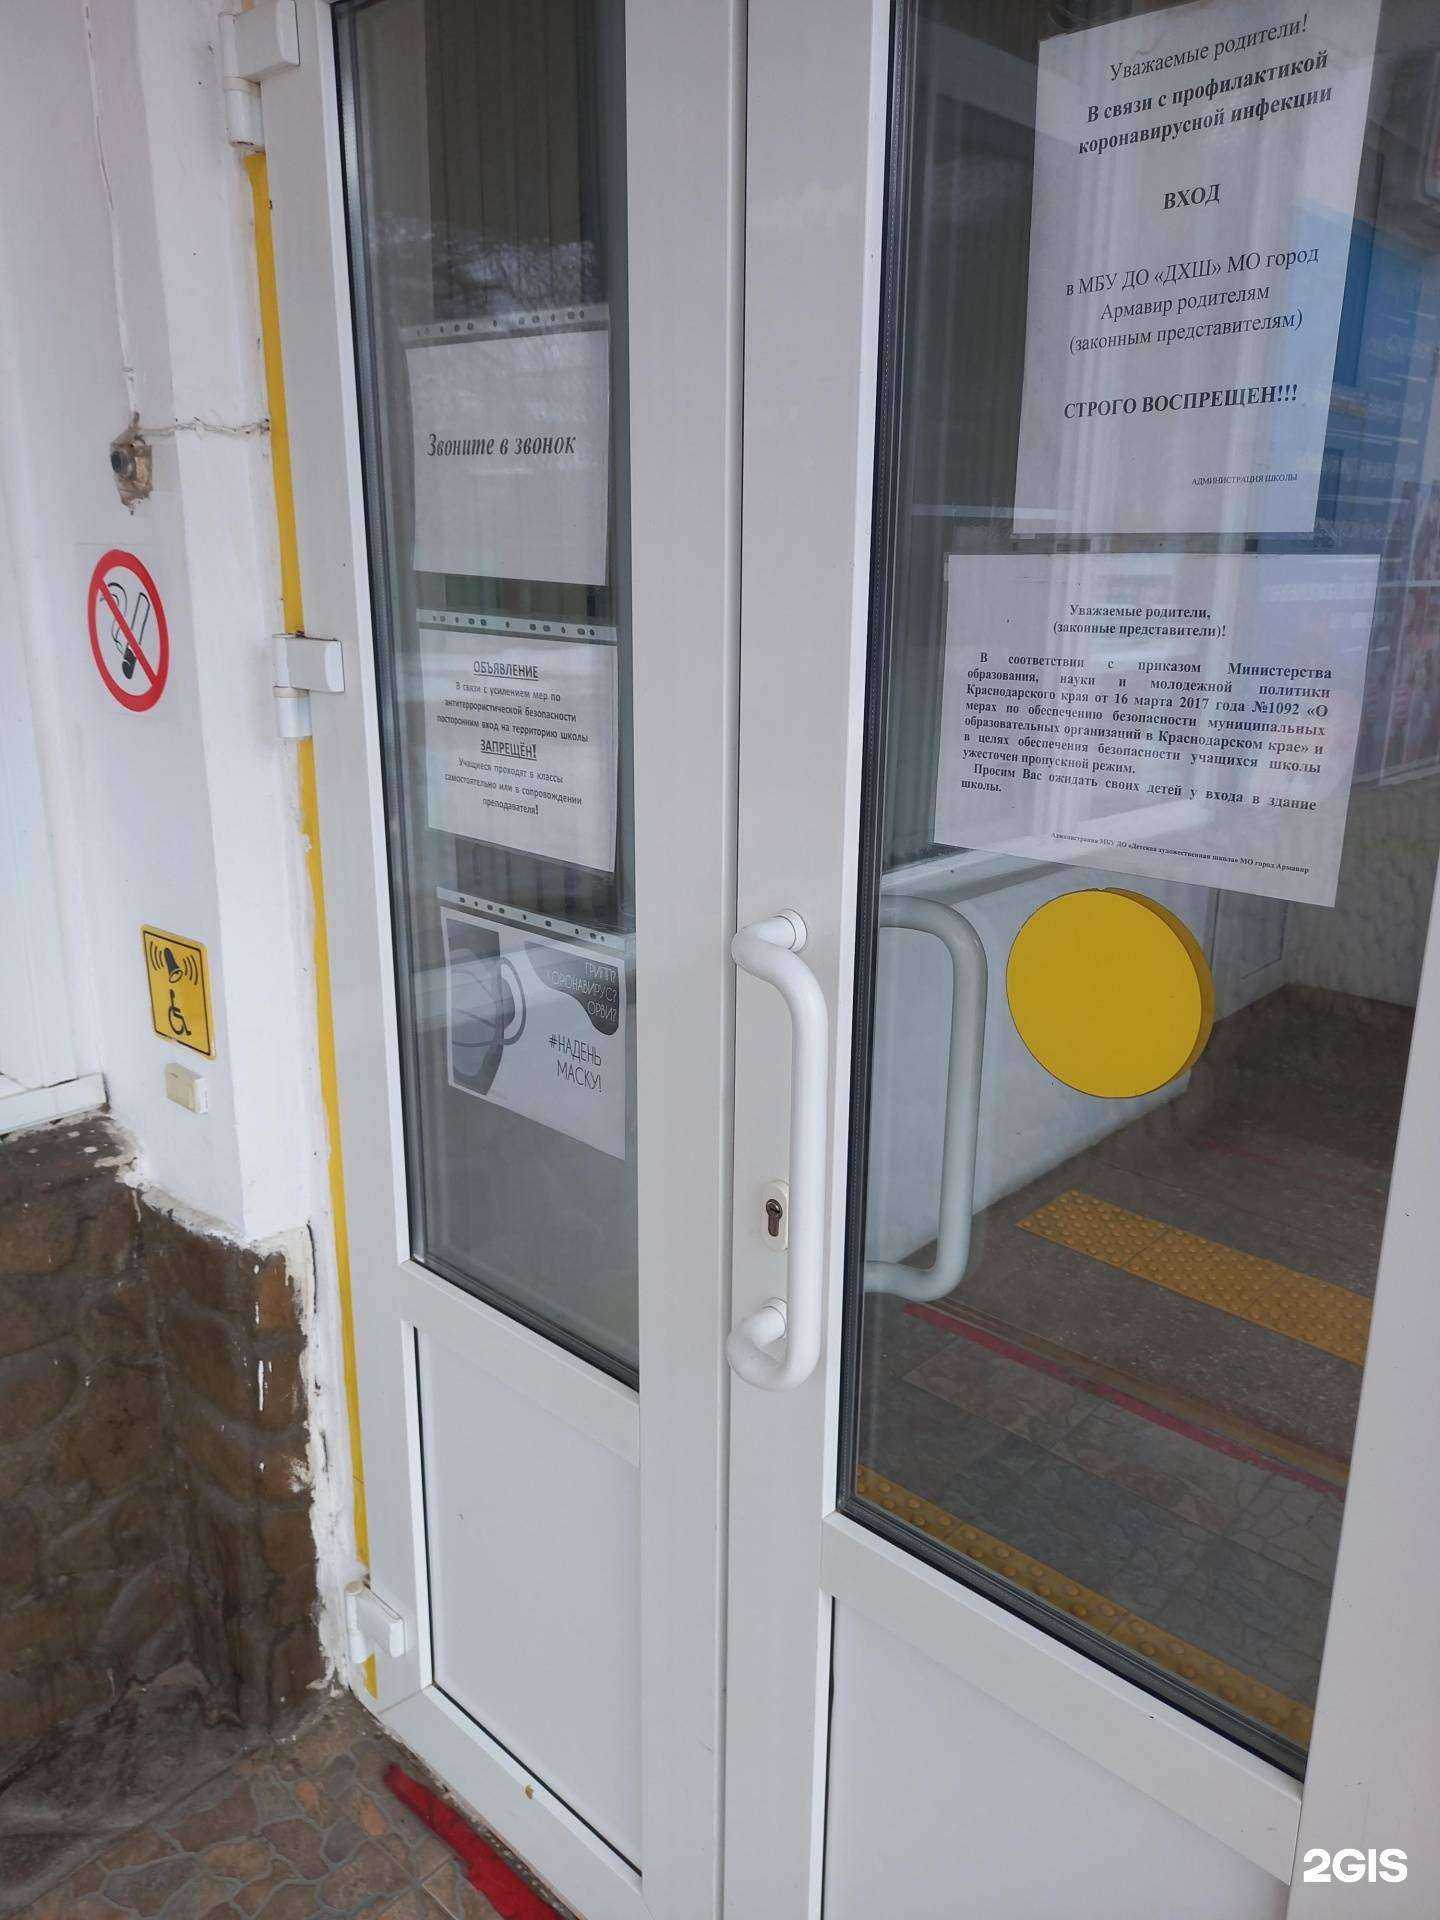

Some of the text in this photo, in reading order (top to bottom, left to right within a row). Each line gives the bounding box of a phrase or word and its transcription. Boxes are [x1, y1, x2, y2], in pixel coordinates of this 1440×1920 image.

[1109, 13, 1308, 82] Уважаемые родители!
[1087, 50, 1328, 123] В связи с профилактикой
[1078, 85, 1333, 155] коронавирусной инфекции
[1163, 184, 1220, 210] ВХОД
[1066, 247, 1319, 296] в МБУ ДО «ДХШ» МО город
[1101, 286, 1270, 321] Армавир родителям
[1069, 309, 1303, 354] (законным представителям)
[1065, 384, 1297, 419] СТРОГО ВОСПРЕЩЕН!!!
[427, 433, 576, 457] Звоните в звонок
[1192, 473, 1298, 486] АДМИНИСТРАЦИЯ ШКОЛЫ
[1070, 604, 1211, 621] Уважаемые родители,
[1053, 622, 1226, 639] (законные представители)!
[473, 660, 539, 680] ОБЪЯВЛЕНИЕ
[980, 653, 988, 663] В
[1008, 655, 1084, 668] соответствии
[1138, 661, 1201, 673] приказом
[1227, 663, 1332, 680] Министерства
[462, 684, 481, 693] связи
[490, 687, 530, 699] усилением
[532, 692, 547, 702] мер
[550, 694, 561, 702] по
[967, 669, 1330, 698] образования, науки и молодежной политики
[525, 707, 577, 723] безопасности
[966, 684, 1328, 717] Краснодарского края от 16 марта 2017 года №1092 «О
[482, 722, 499, 731] вход
[502, 724, 510, 732] на
[512, 726, 557, 741] территорию
[560, 733, 589, 743] школы
[965, 702, 1326, 736] мерах по обеспечению безопасности муниципальных
[481, 738, 537, 760] ЗАПРЕЩЁН!
[965, 716, 1323, 755] образовательных организаций в Краснодарском крае» и
[962, 747, 1136, 774] ужесточен пропускной режим.
[964, 733, 1321, 773] в целях обеспечения безопасности учащихся школы
[458, 757, 492, 771] Учащиеся
[494, 764, 527, 778] проходят
[537, 772, 564, 784] классы
[961, 778, 1002, 792] школы.
[444, 773, 497, 789] самостоятельно
[499, 783, 513, 793] или
[522, 788, 582, 805] сопровождении
[974, 764, 1317, 810] Просим Вас ожидать своих детей у входа в здание
[483, 797, 539, 815] преподавателя!
[549, 1034, 601, 1066] #НАДЕНЬ
[557, 1060, 602, 1093] МАСКУ!
